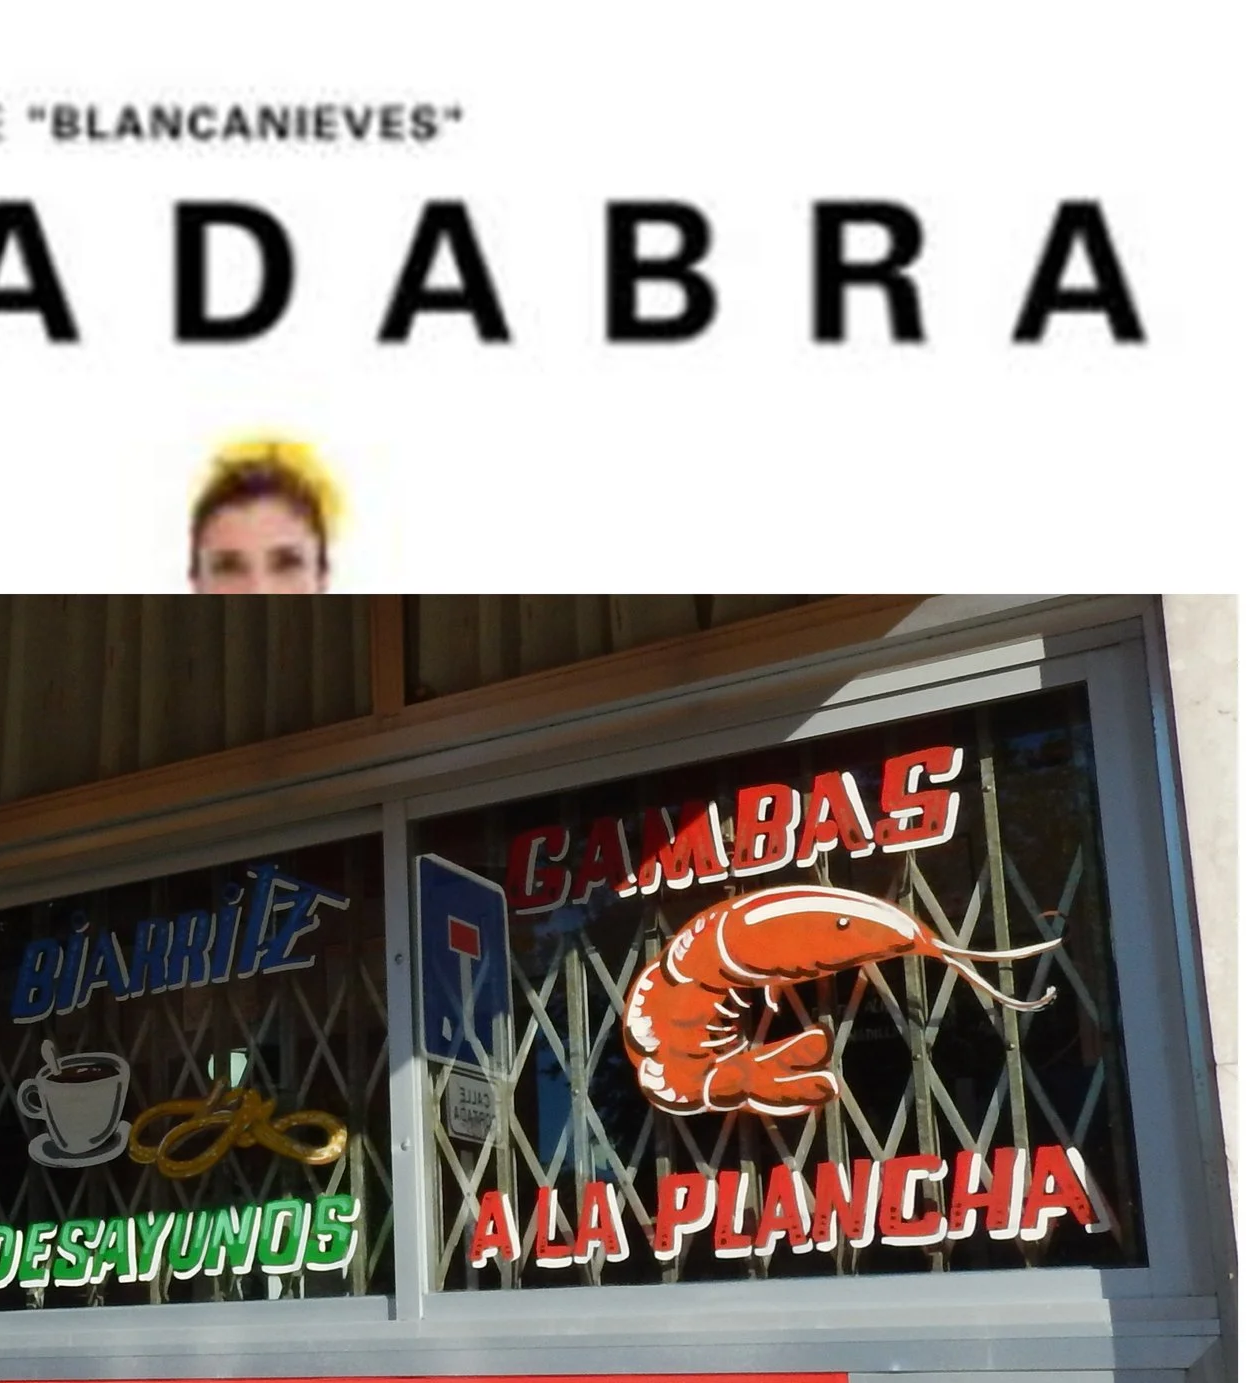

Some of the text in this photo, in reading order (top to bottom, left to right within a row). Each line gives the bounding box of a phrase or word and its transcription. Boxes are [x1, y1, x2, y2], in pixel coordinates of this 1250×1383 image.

[27, 103, 464, 140] "BLANCANIEVES"
[505, 746, 963, 914] GAMBAS
[469, 1145, 1111, 1269] A LA PLANCHA
